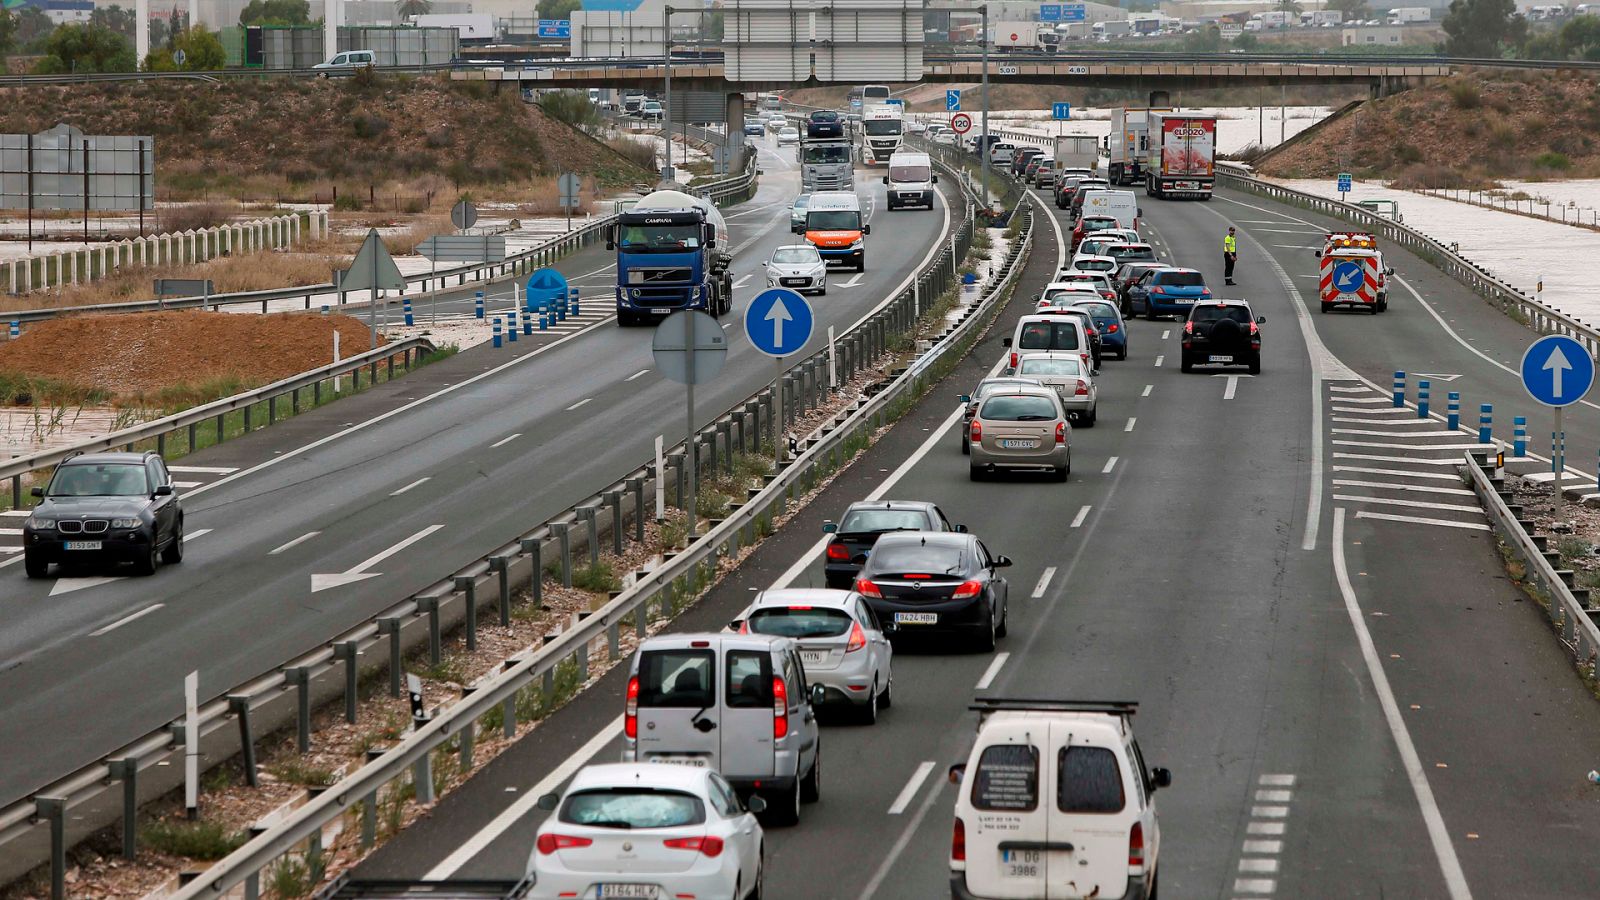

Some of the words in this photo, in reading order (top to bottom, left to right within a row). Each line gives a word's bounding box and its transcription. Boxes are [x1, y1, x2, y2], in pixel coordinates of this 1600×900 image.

[900, 613, 919, 622] 9424
[920, 613, 936, 622] HBH
[1011, 852, 1017, 862] A
[1010, 866, 1037, 877] 3986
[603, 884, 632, 896] 9164
[634, 884, 657, 896] HLK
